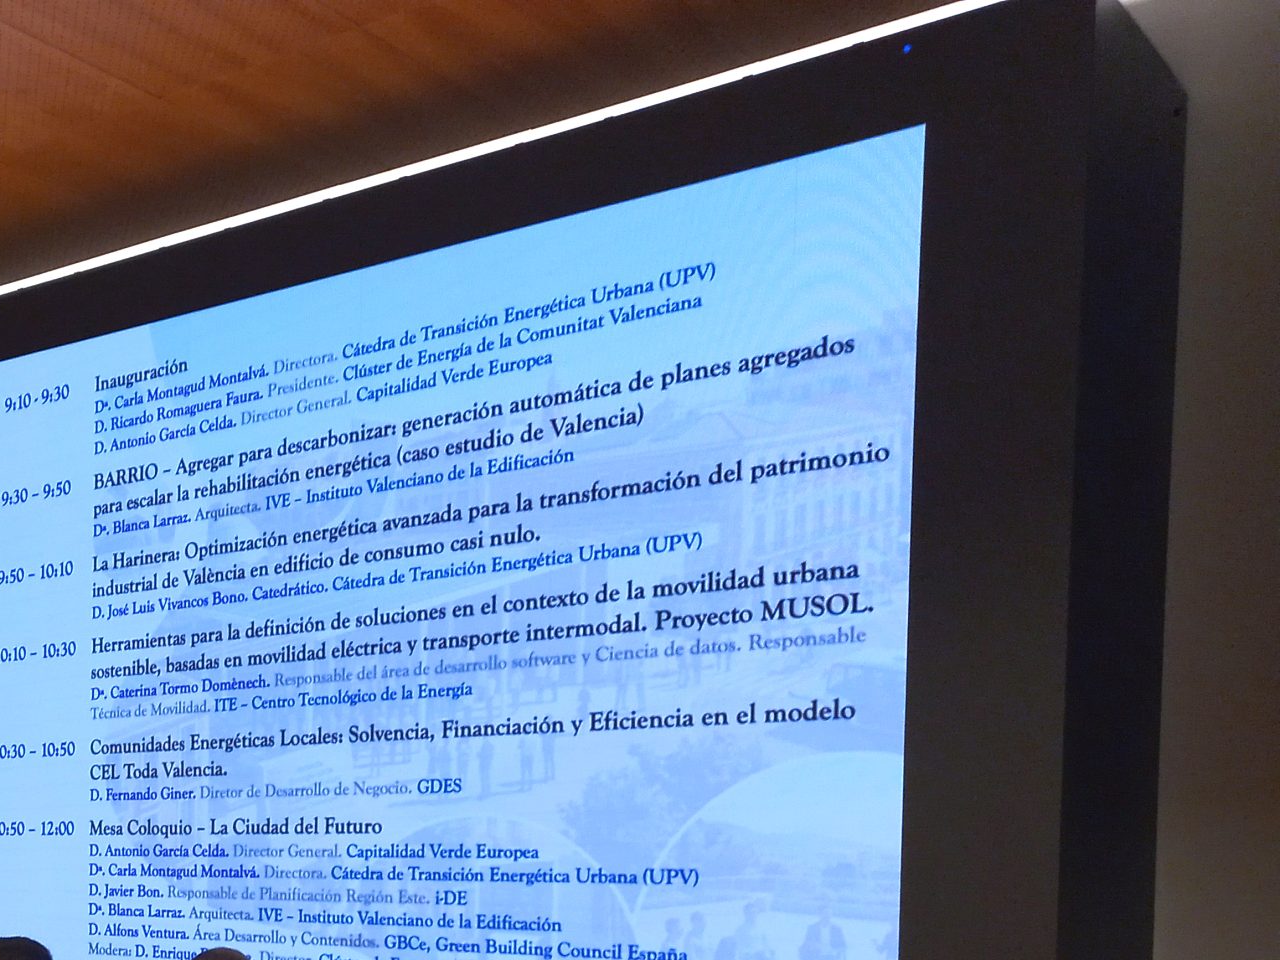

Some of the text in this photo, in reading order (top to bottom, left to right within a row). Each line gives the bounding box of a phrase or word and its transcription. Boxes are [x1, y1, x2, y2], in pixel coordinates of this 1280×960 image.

[113, 390, 145, 410] Carla
[146, 376, 206, 403] Montagud
[208, 364, 270, 389] Montalvá.
[273, 353, 339, 375] Directora.
[341, 336, 397, 359] Cátedra
[399, 330, 417, 347] de
[419, 314, 499, 342] Transición
[503, 295, 587, 324] Energética
[591, 281, 655, 304] Urbana
[658, 262, 716, 291] (UPV)
[95, 359, 188, 392] Inauguración
[4, 393, 32, 413] 9:10
[40, 384, 70, 404] 9:30
[93, 463, 159, 490] BARRIO
[174, 454, 235, 477] Agregar
[238, 447, 273, 468] para
[276, 424, 397, 457] descarbonizar:
[401, 401, 504, 437] generación
[509, 379, 623, 414] automática
[627, 370, 655, 392] de
[660, 361, 732, 391] planes
[737, 335, 855, 375] agregados
[93, 403, 645, 519] para escalar la rehabilitación energética (caso estudio de Valencia)
[1, 488, 29, 506] 9:30
[42, 480, 72, 499] 9:50
[92, 442, 891, 572] La Harinera: Optimización energética avanzada para la transformación del patrimonio
[40, 561, 74, 579] 10:10
[90, 592, 874, 679] sostenible, basadas en movilidad eléctrica y transporte intermodal. Proyecto MUSOL.
[42, 641, 77, 658] 10:30
[89, 698, 856, 756] Comunidades Energéticas Locales: Solvencia, Financiación y Eficiencia en el modelo
[41, 741, 76, 757] 10:50
[89, 760, 228, 781] CEL Toda Valencia.
[89, 778, 463, 802] D. Fernando Giner. Diretor de Desarrollo de Negocio. GDES
[40, 821, 75, 836] 12:00
[89, 820, 124, 836] Mesa
[126, 819, 193, 839] Coloquio
[209, 818, 229, 835] La
[232, 817, 290, 835] Ciudad
[293, 817, 320, 835] del
[324, 817, 383, 834] Futuro
[88, 922, 102, 935] D.
[103, 923, 140, 937] Alfons
[140, 924, 190, 940] Ventura.
[192, 925, 221, 941] Área
[223, 928, 287, 944] Desarrollo
[289, 936, 299, 947] y
[300, 930, 381, 948] Contenidos.
[383, 934, 431, 953] GBCe,
[435, 937, 482, 953] Green
[484, 938, 554, 960] Building
[556, 942, 623, 960] Council
[88, 942, 132, 957] Modera:
[134, 944, 149, 958] D.
